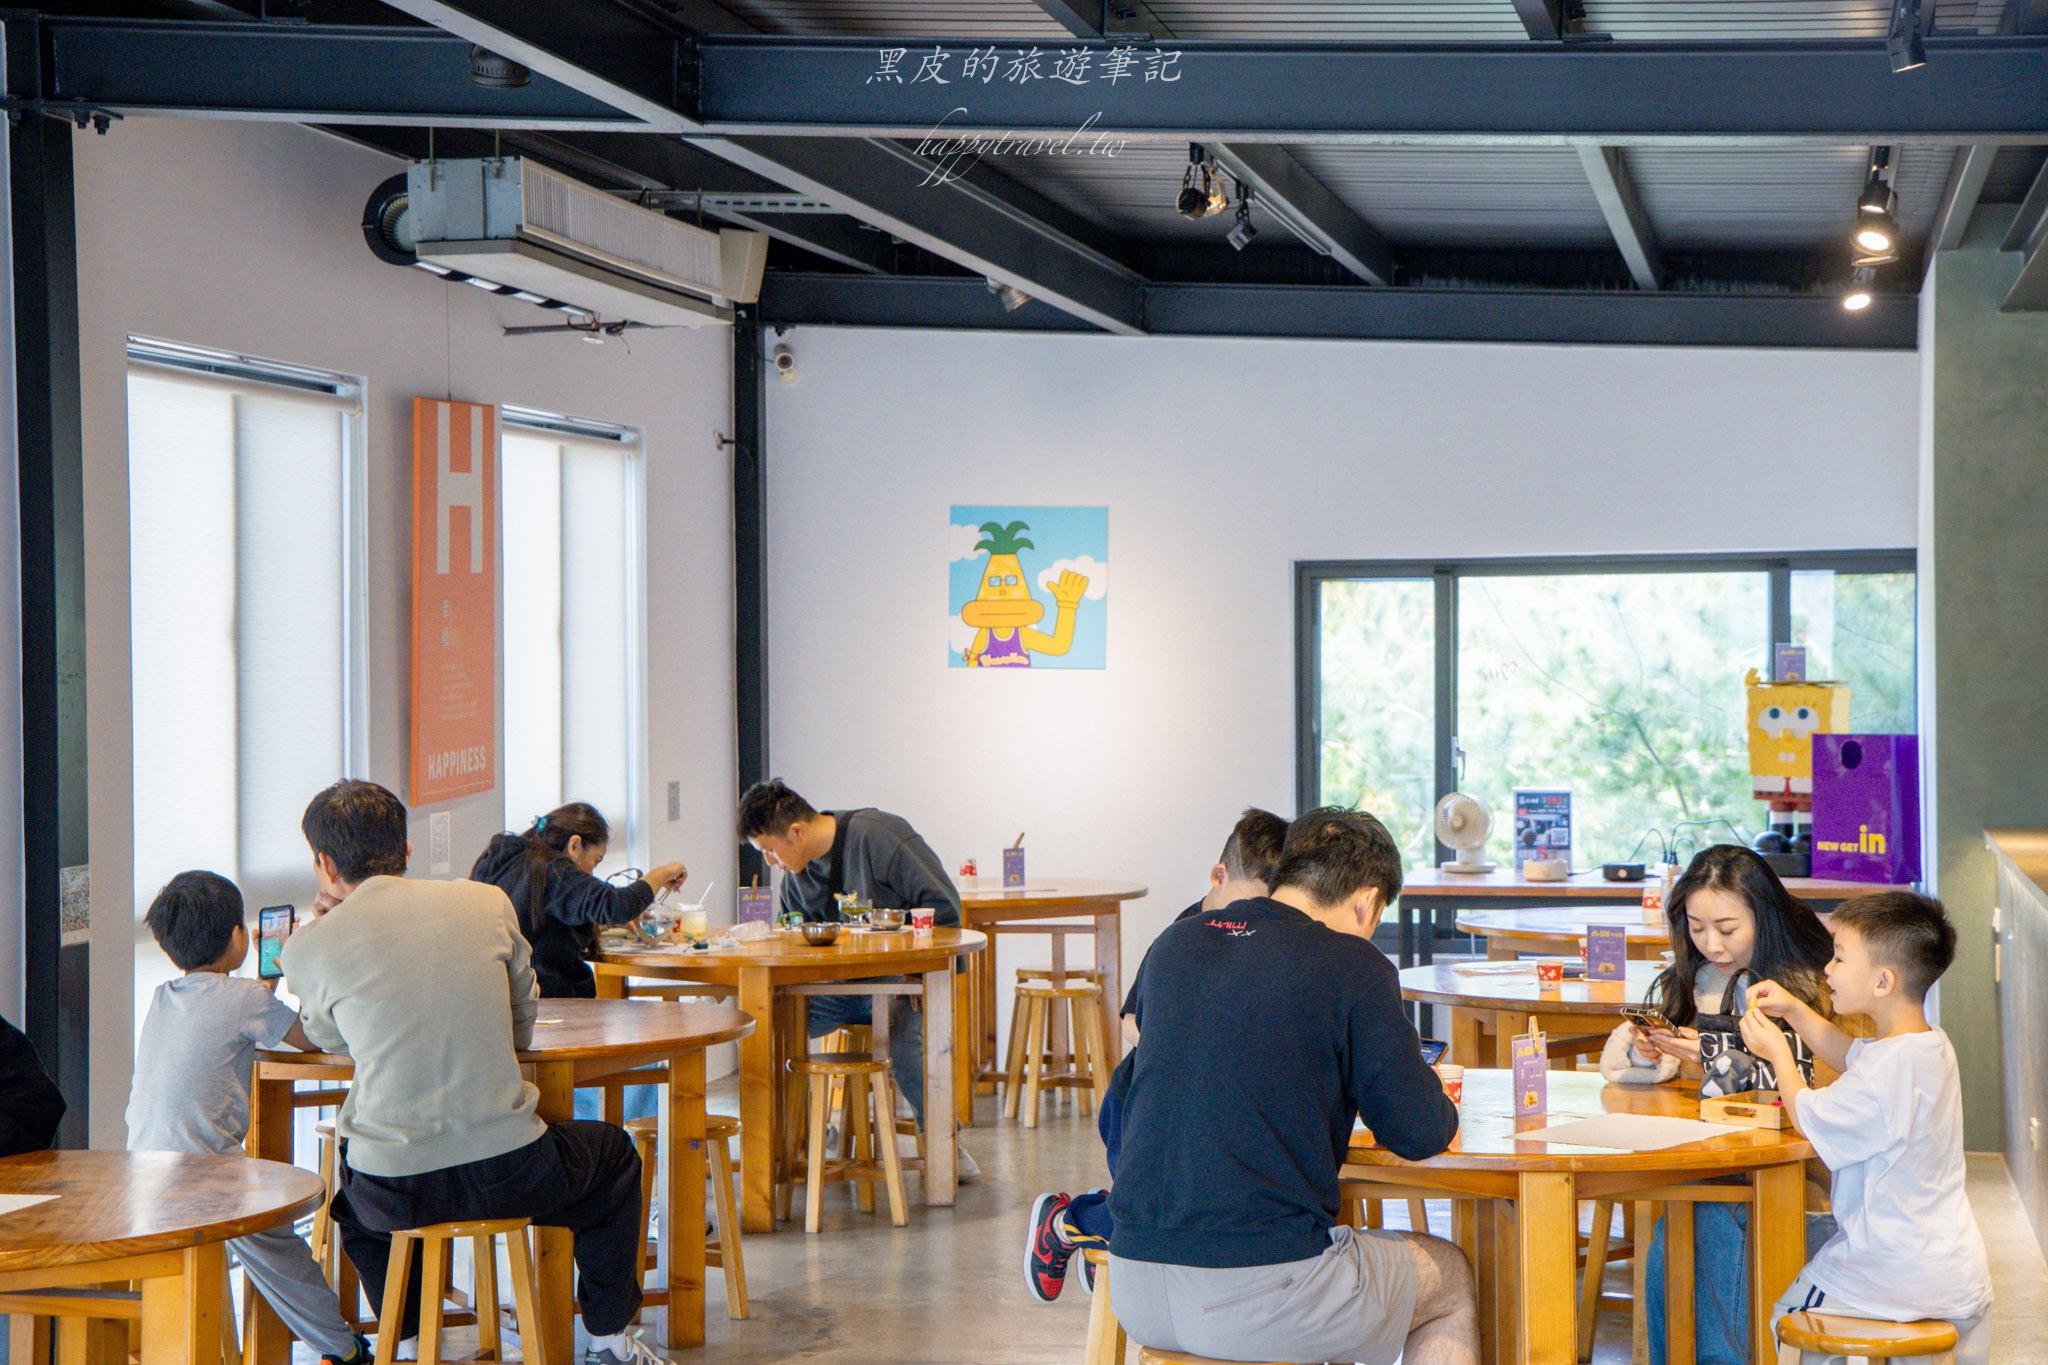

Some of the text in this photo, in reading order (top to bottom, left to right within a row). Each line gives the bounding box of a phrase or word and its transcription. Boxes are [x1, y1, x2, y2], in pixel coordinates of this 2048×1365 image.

[436, 401, 484, 574] H
[428, 745, 487, 780] HAPPINESS
[1817, 841, 1839, 851] NEW
[1859, 824, 1887, 854] in
